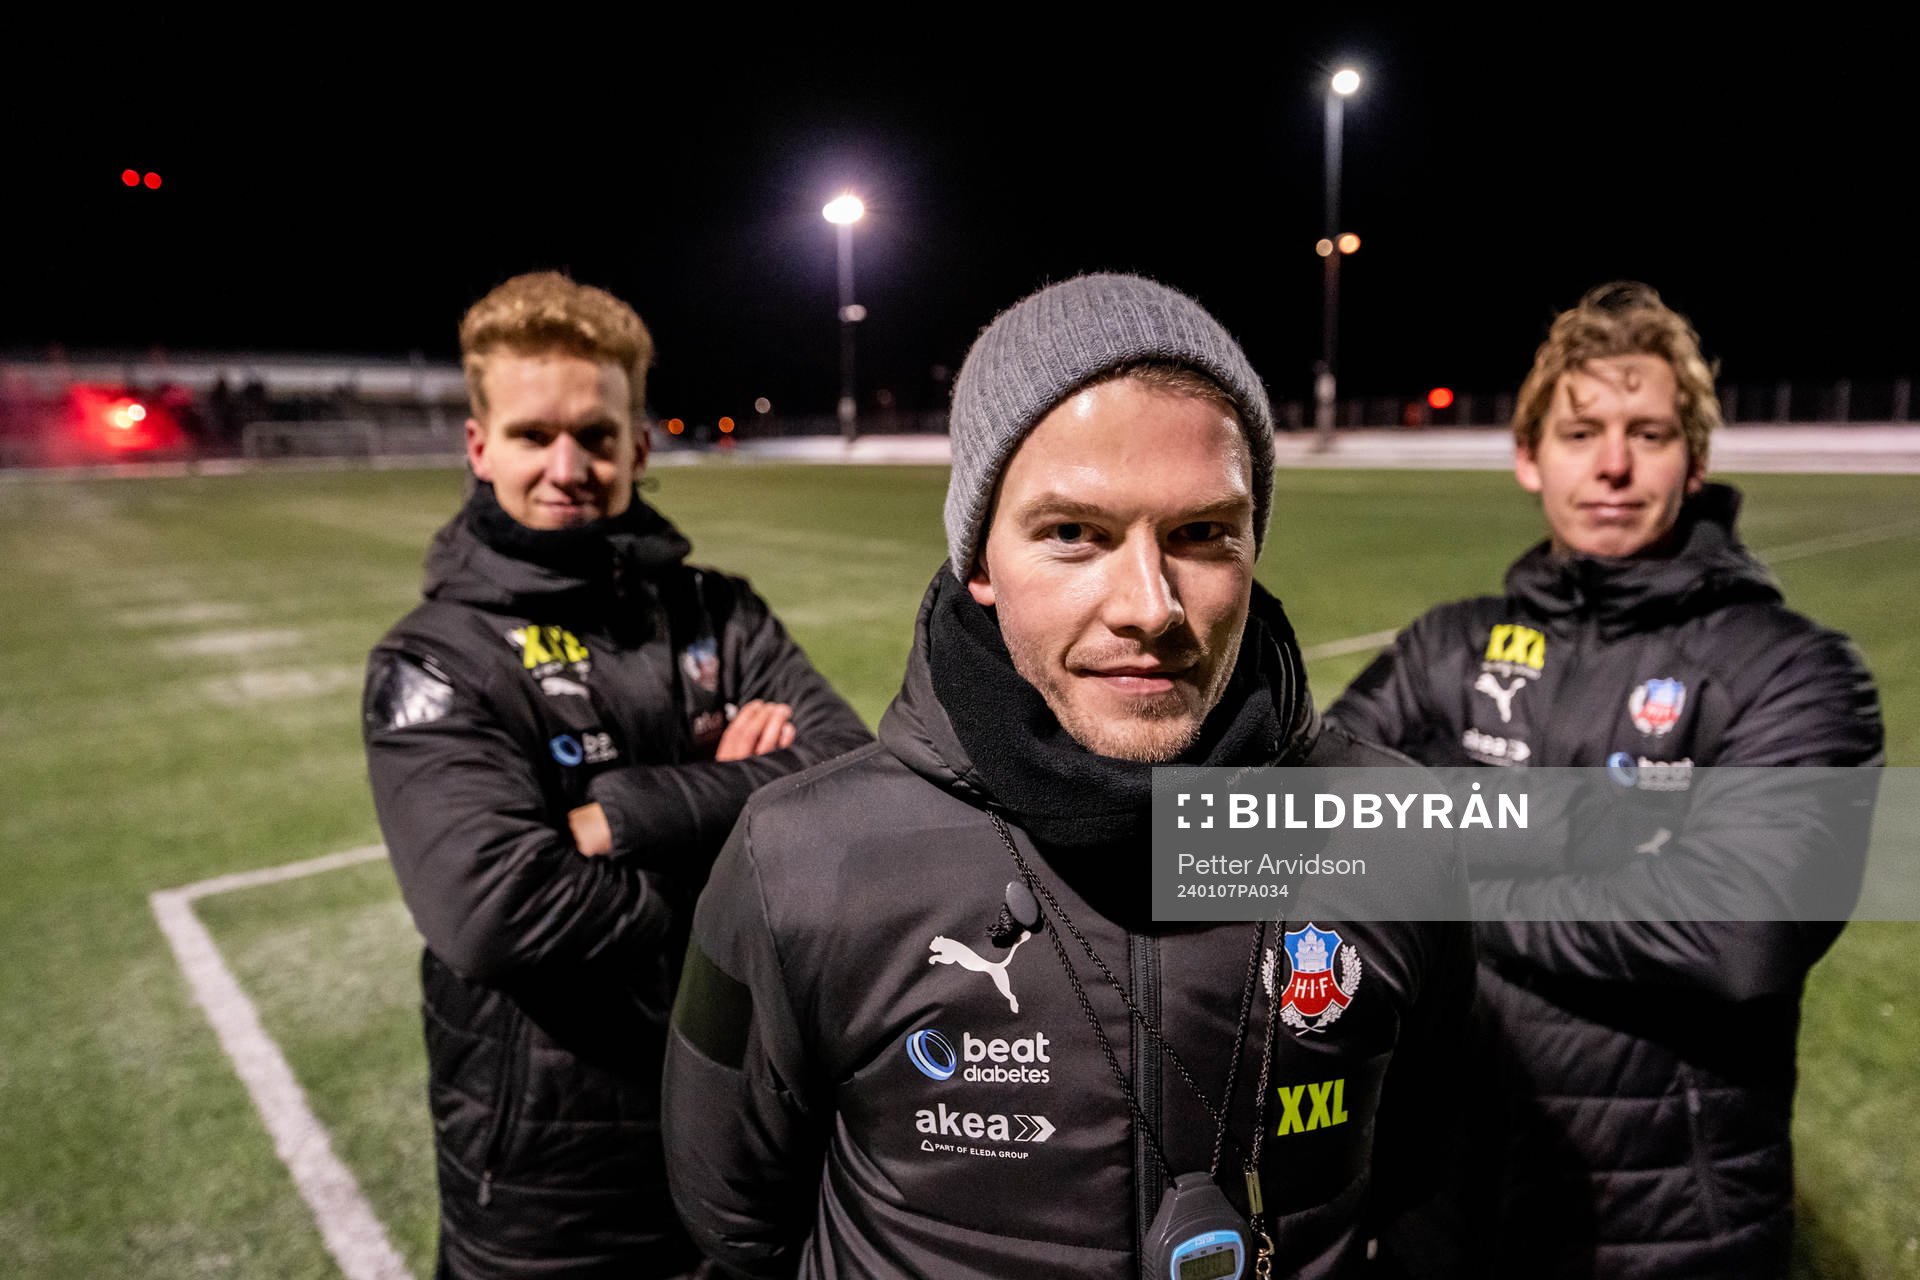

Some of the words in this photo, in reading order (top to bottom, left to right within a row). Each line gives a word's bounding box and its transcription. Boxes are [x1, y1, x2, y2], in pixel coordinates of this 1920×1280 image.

[1485, 624, 1546, 670] XXL
[963, 1031, 1050, 1063] beat
[915, 1103, 1010, 1141] akea
[1277, 1078, 1348, 1136] XXL
[934, 1143, 954, 1152] PART
[956, 1146, 967, 1154] OF
[970, 1148, 996, 1158] ELEDA
[999, 1150, 1029, 1160] GROUP
